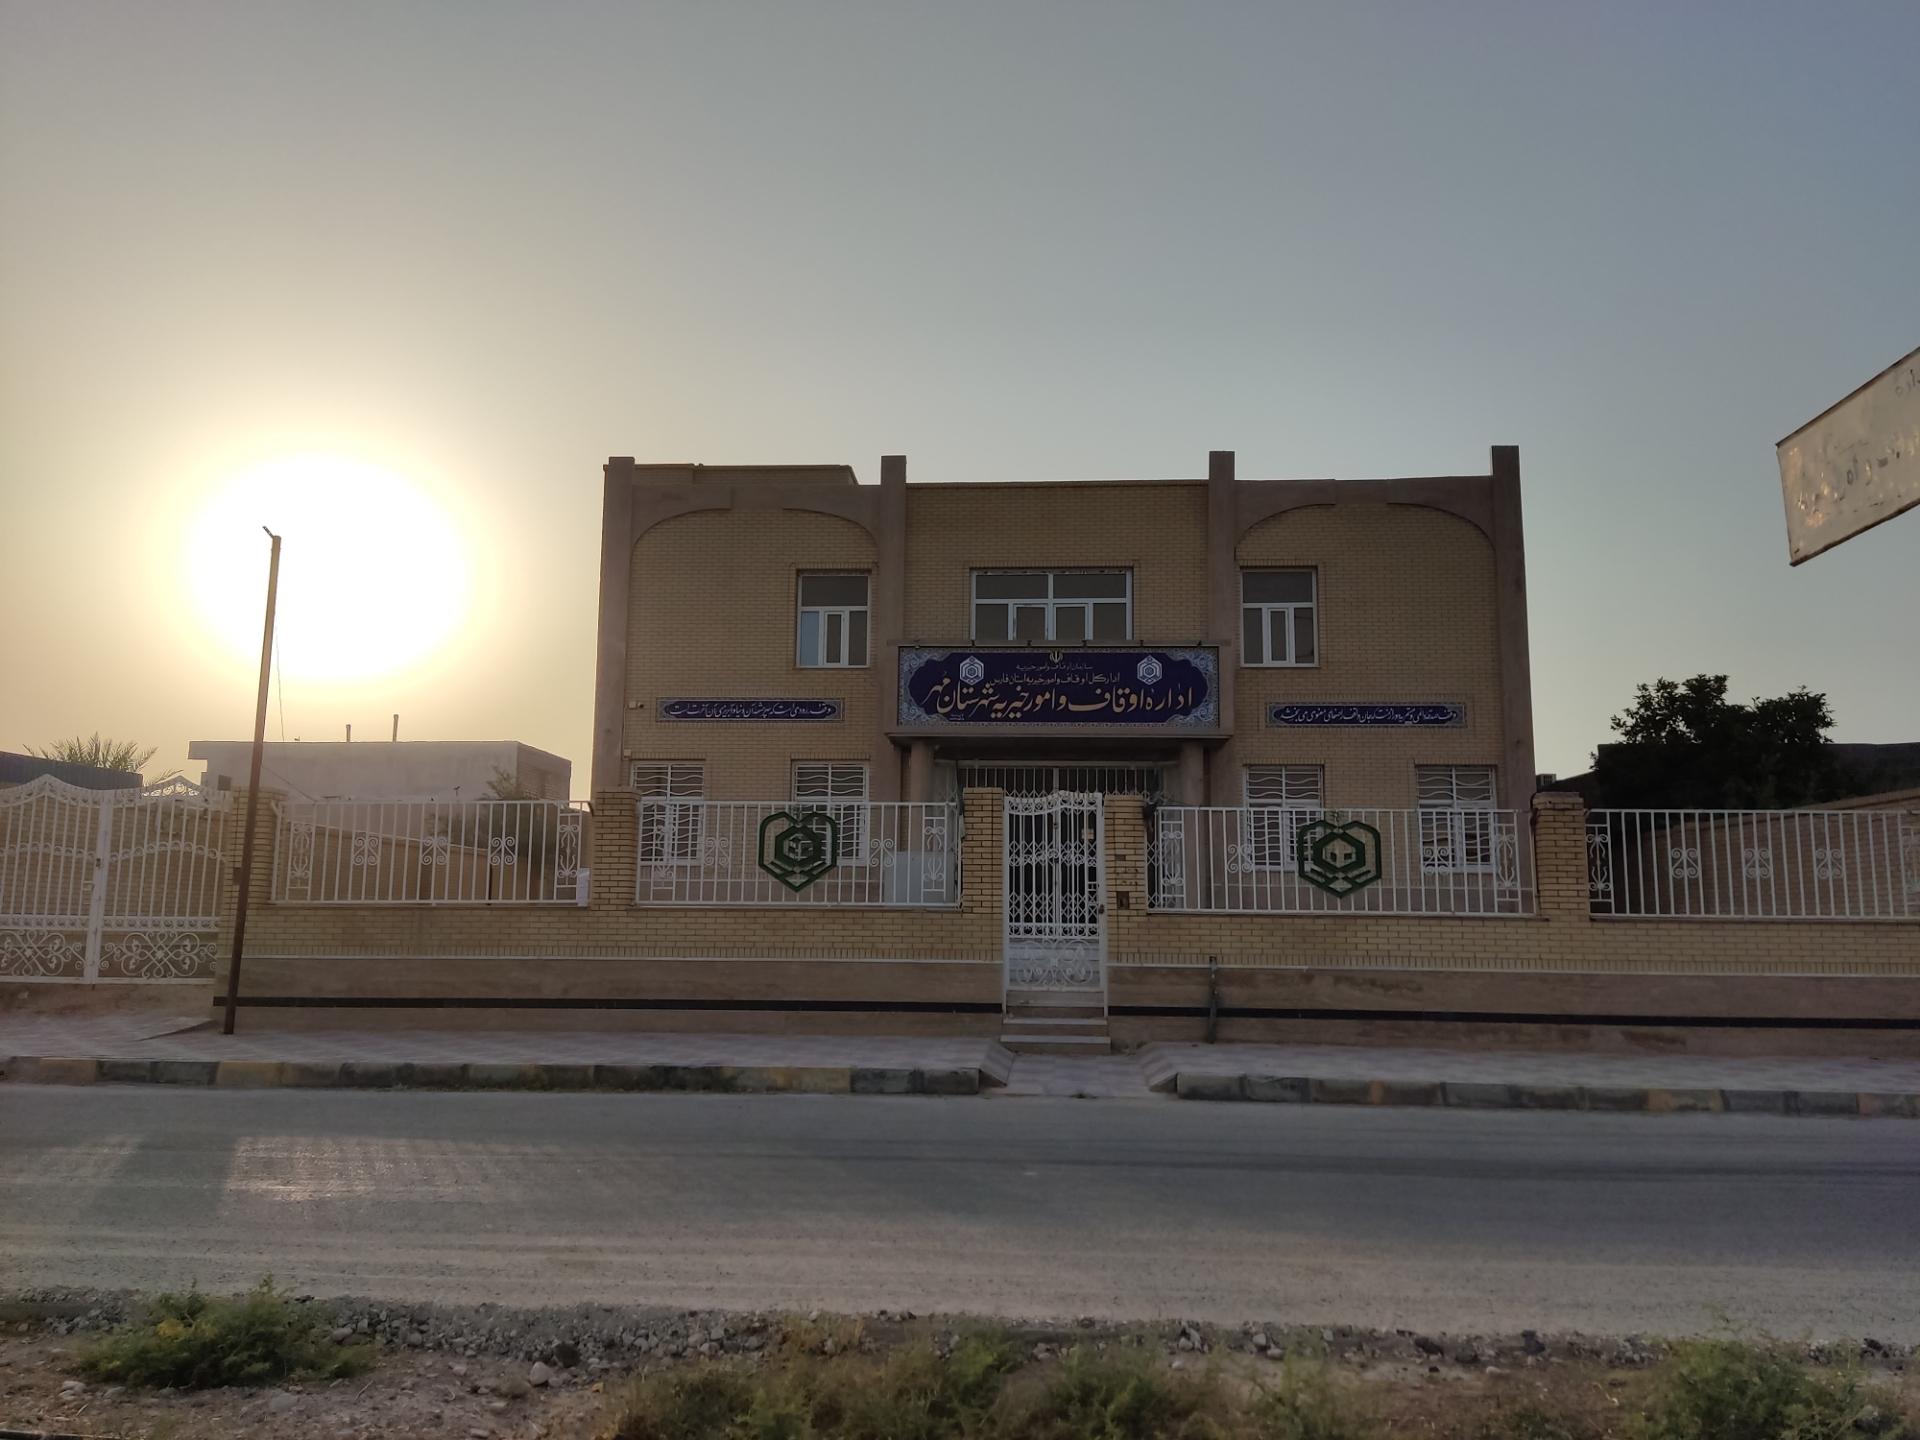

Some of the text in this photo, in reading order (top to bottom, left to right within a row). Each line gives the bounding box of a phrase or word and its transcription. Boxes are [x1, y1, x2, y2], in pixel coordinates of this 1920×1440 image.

[990, 672, 1008, 686] فارس
[1009, 672, 1026, 685] استان
[1025, 673, 1044, 685] خیریه
[1042, 672, 1056, 685] امور
[1060, 672, 1088, 685] اوقاف
[936, 680, 1001, 718] شهرستان
[990, 685, 1030, 718] خیریه
[1023, 687, 1056, 712] امور
[1056, 694, 1067, 711] و
[1068, 686, 1144, 712] اوقاف
[1147, 683, 1192, 711] اداره
